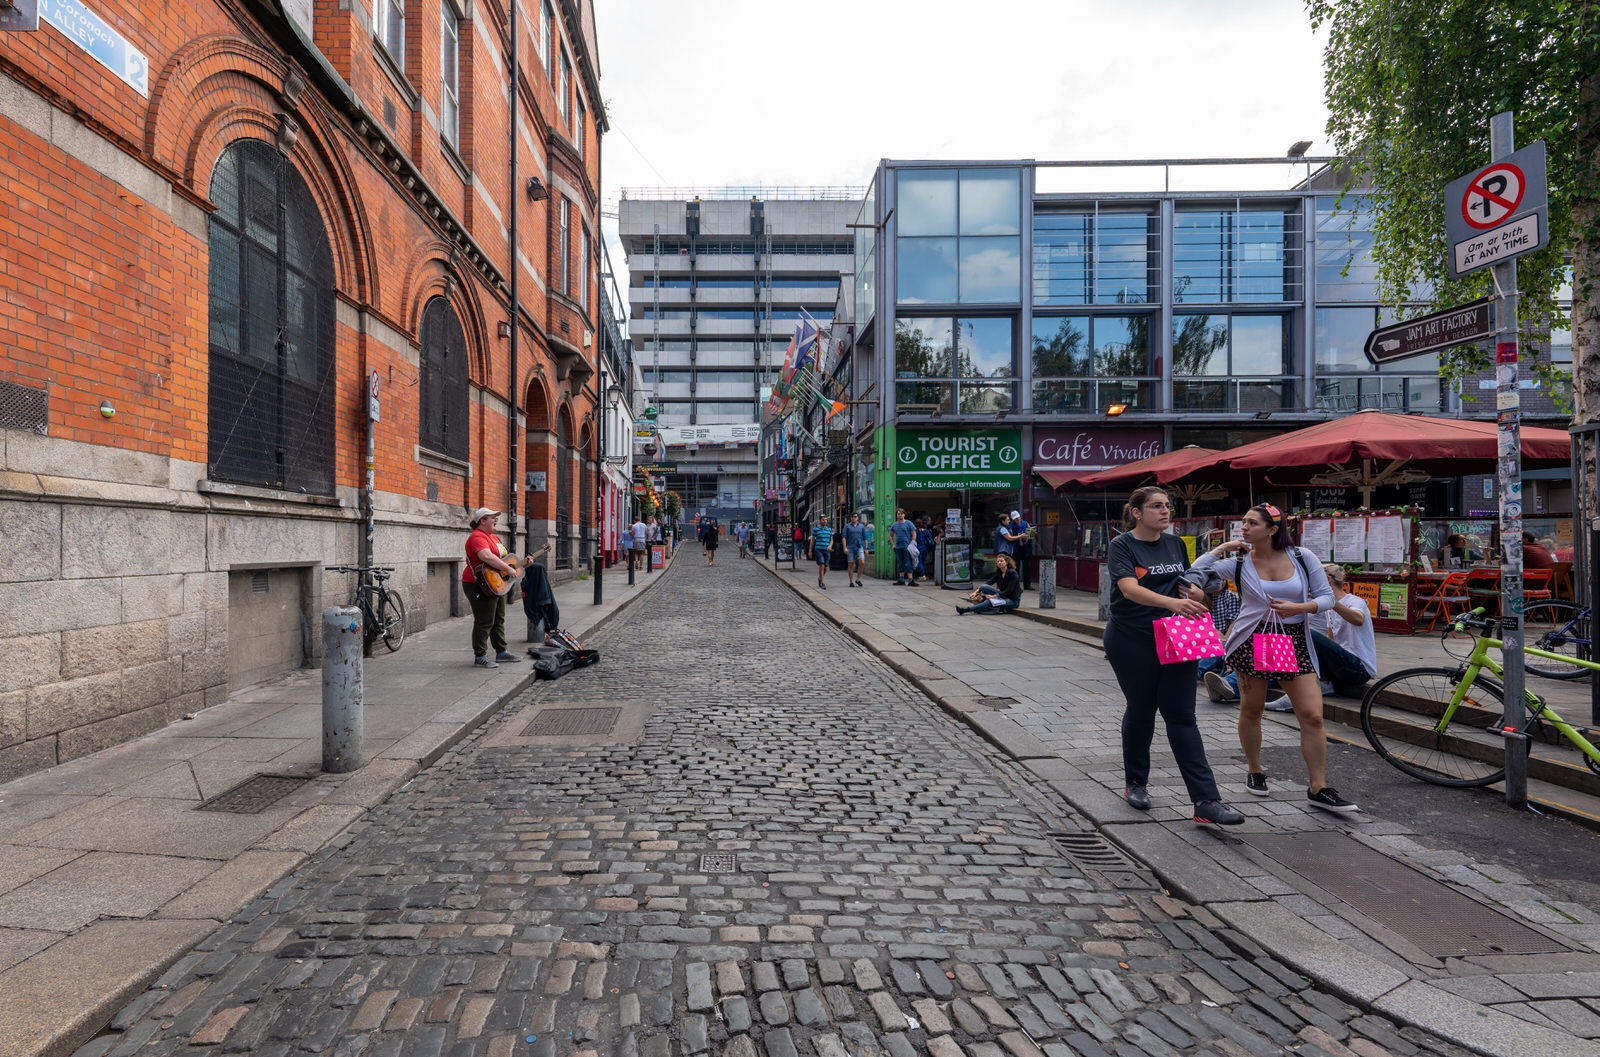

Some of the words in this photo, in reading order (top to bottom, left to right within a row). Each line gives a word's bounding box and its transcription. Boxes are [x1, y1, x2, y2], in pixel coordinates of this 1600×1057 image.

[54, 9, 95, 47] ALLEY
[129, 54, 144, 89] 2
[1463, 254, 1475, 266] AT
[1479, 245, 1500, 260] ANY
[1504, 235, 1529, 250] TIME
[1406, 326, 1423, 341] JAM
[1425, 320, 1440, 337] ART
[1442, 309, 1478, 332] FACTORY
[1407, 341, 1427, 351] IRISH
[1429, 337, 1441, 346] ART
[1452, 327, 1479, 339] DESIGN
[918, 436, 998, 451] TOURIST
[1038, 432, 1093, 466] Café
[1100, 440, 1160, 459] Vivaldi
[926, 454, 991, 469] OFFICE
[906, 480, 922, 488] Gifts
[927, 480, 965, 488] Excursions
[969, 480, 1011, 488] Information
[1148, 562, 1185, 575] zaland
